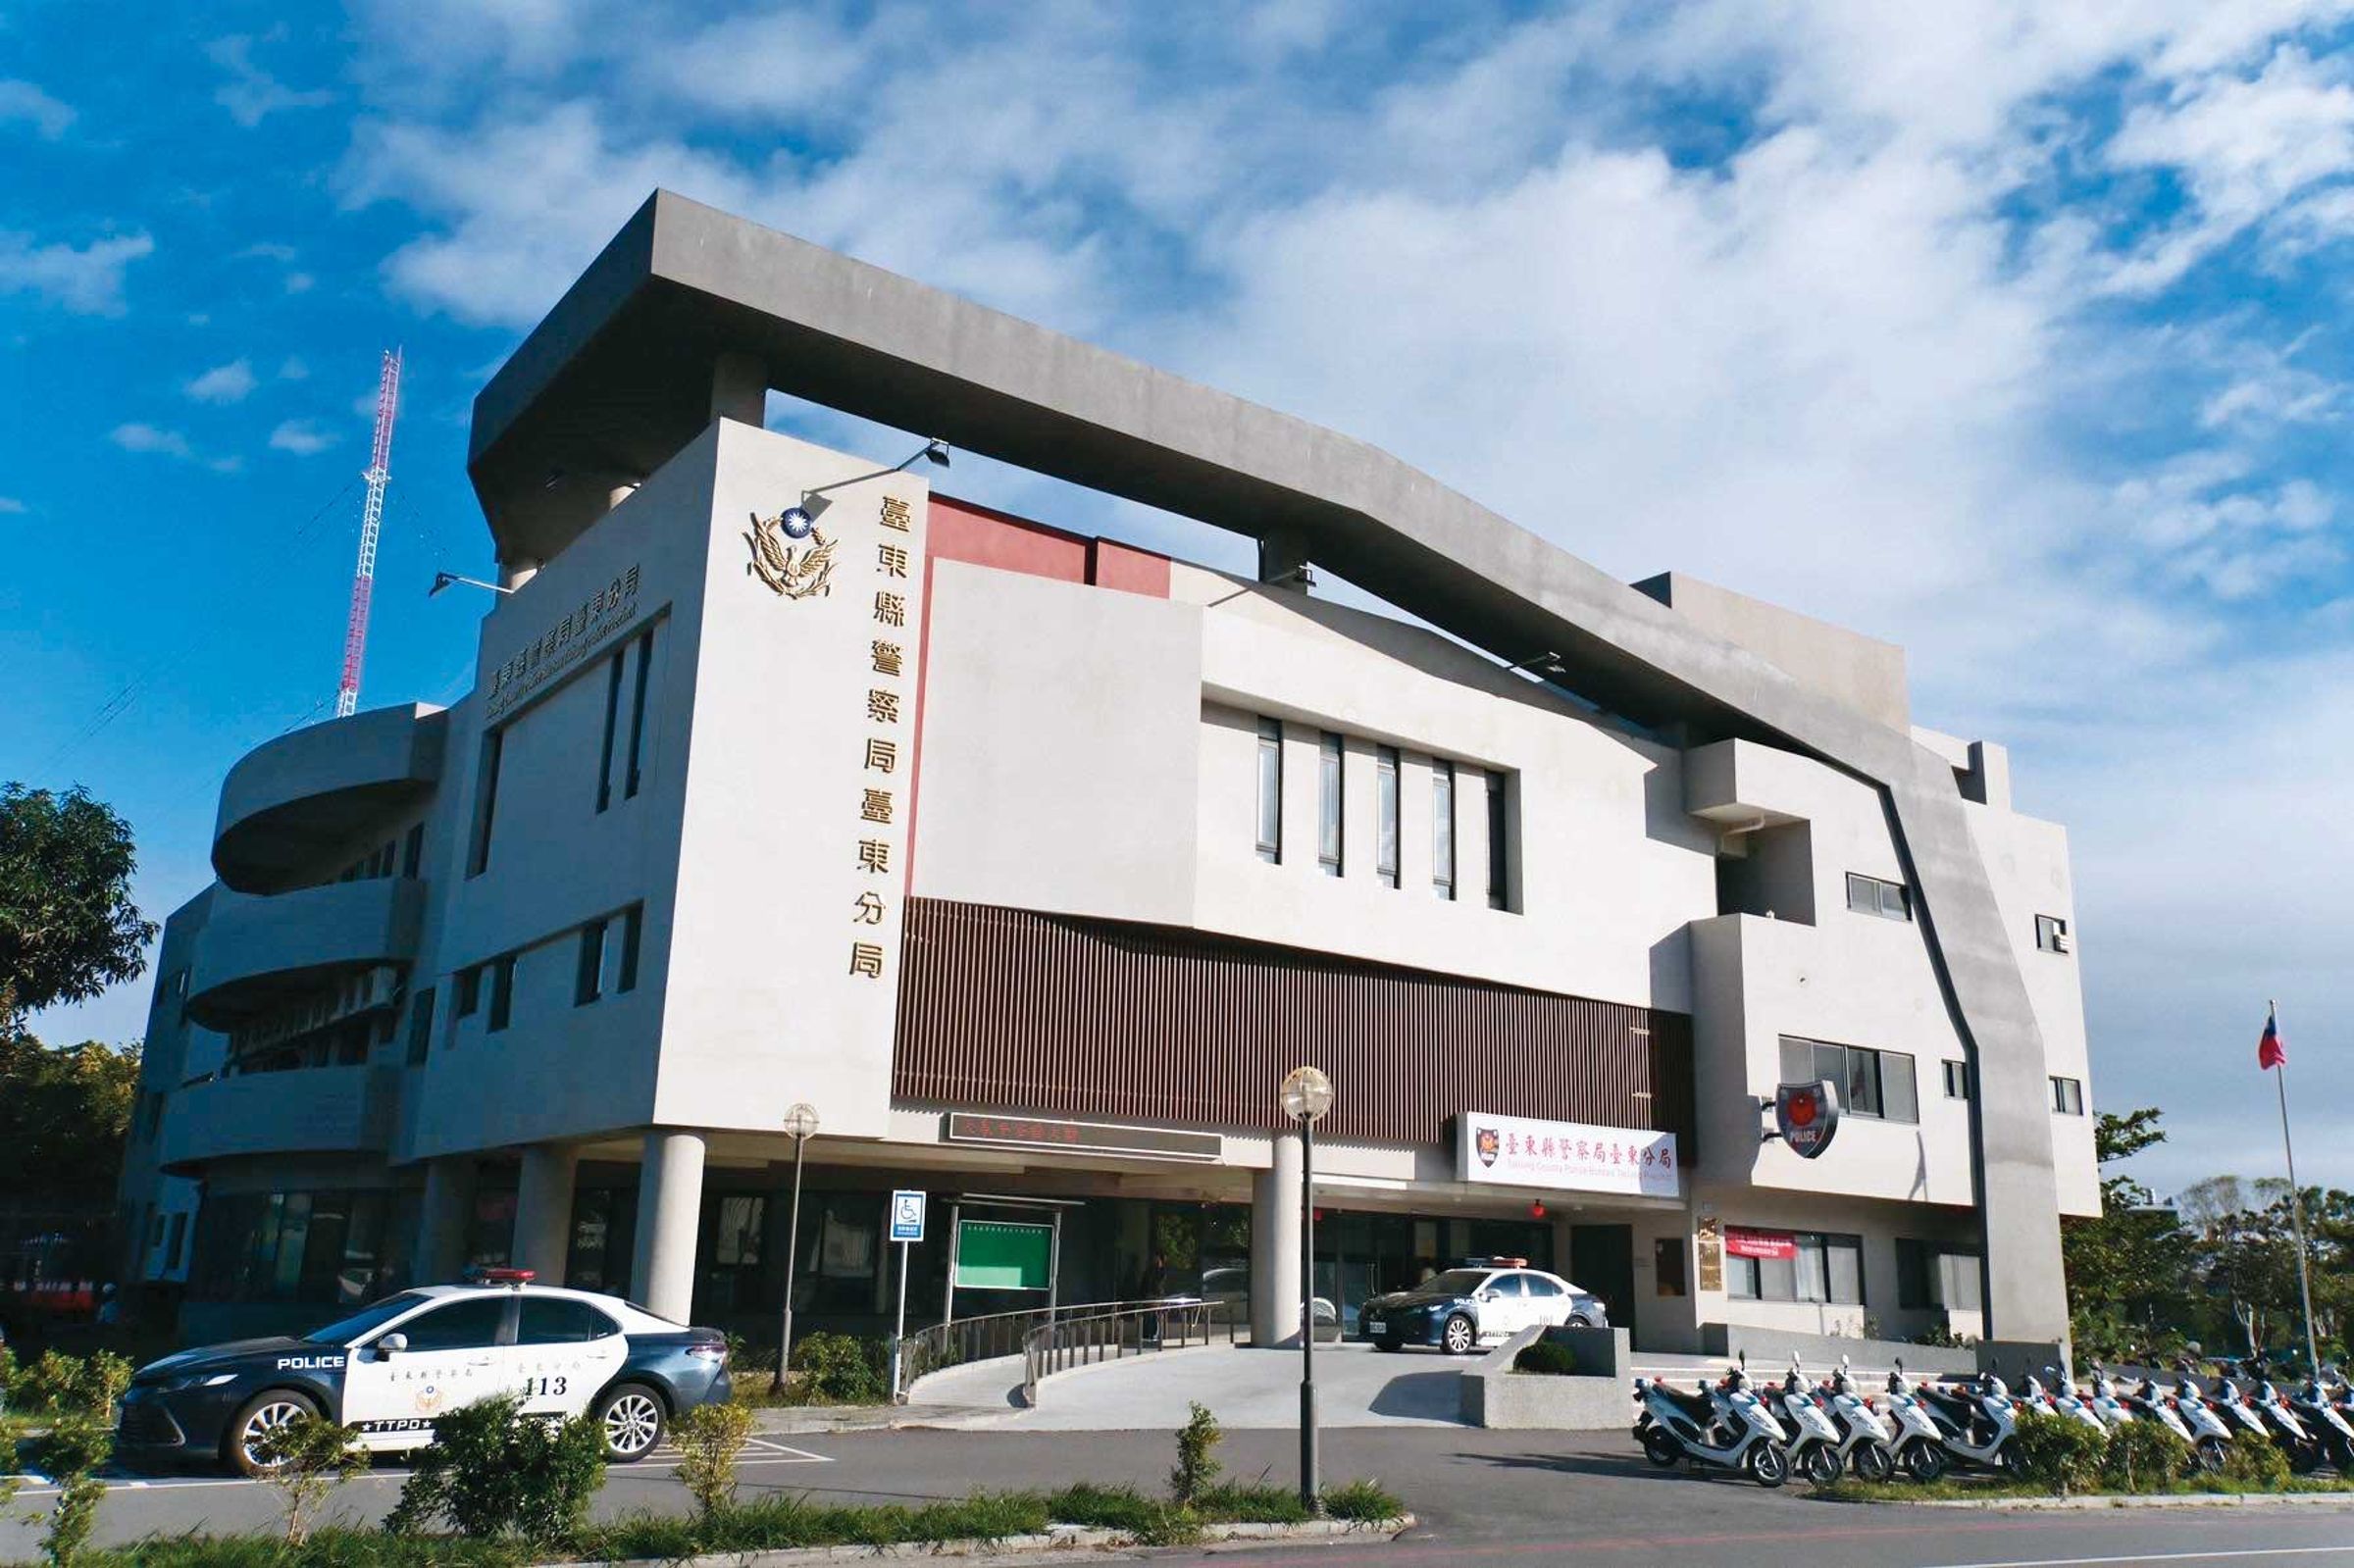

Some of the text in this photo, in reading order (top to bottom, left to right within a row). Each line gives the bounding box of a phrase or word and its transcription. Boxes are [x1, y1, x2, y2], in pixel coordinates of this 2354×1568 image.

[849, 494, 911, 979] 臺東縣警察局臺東分局
[1789, 1129, 1817, 1143] POLICE
[1505, 1132, 1671, 1170] 臺東縣警察局臺東分局
[278, 1356, 344, 1370] POLICE
[525, 1376, 567, 1395] 113
[374, 1420, 420, 1432] TTPD
